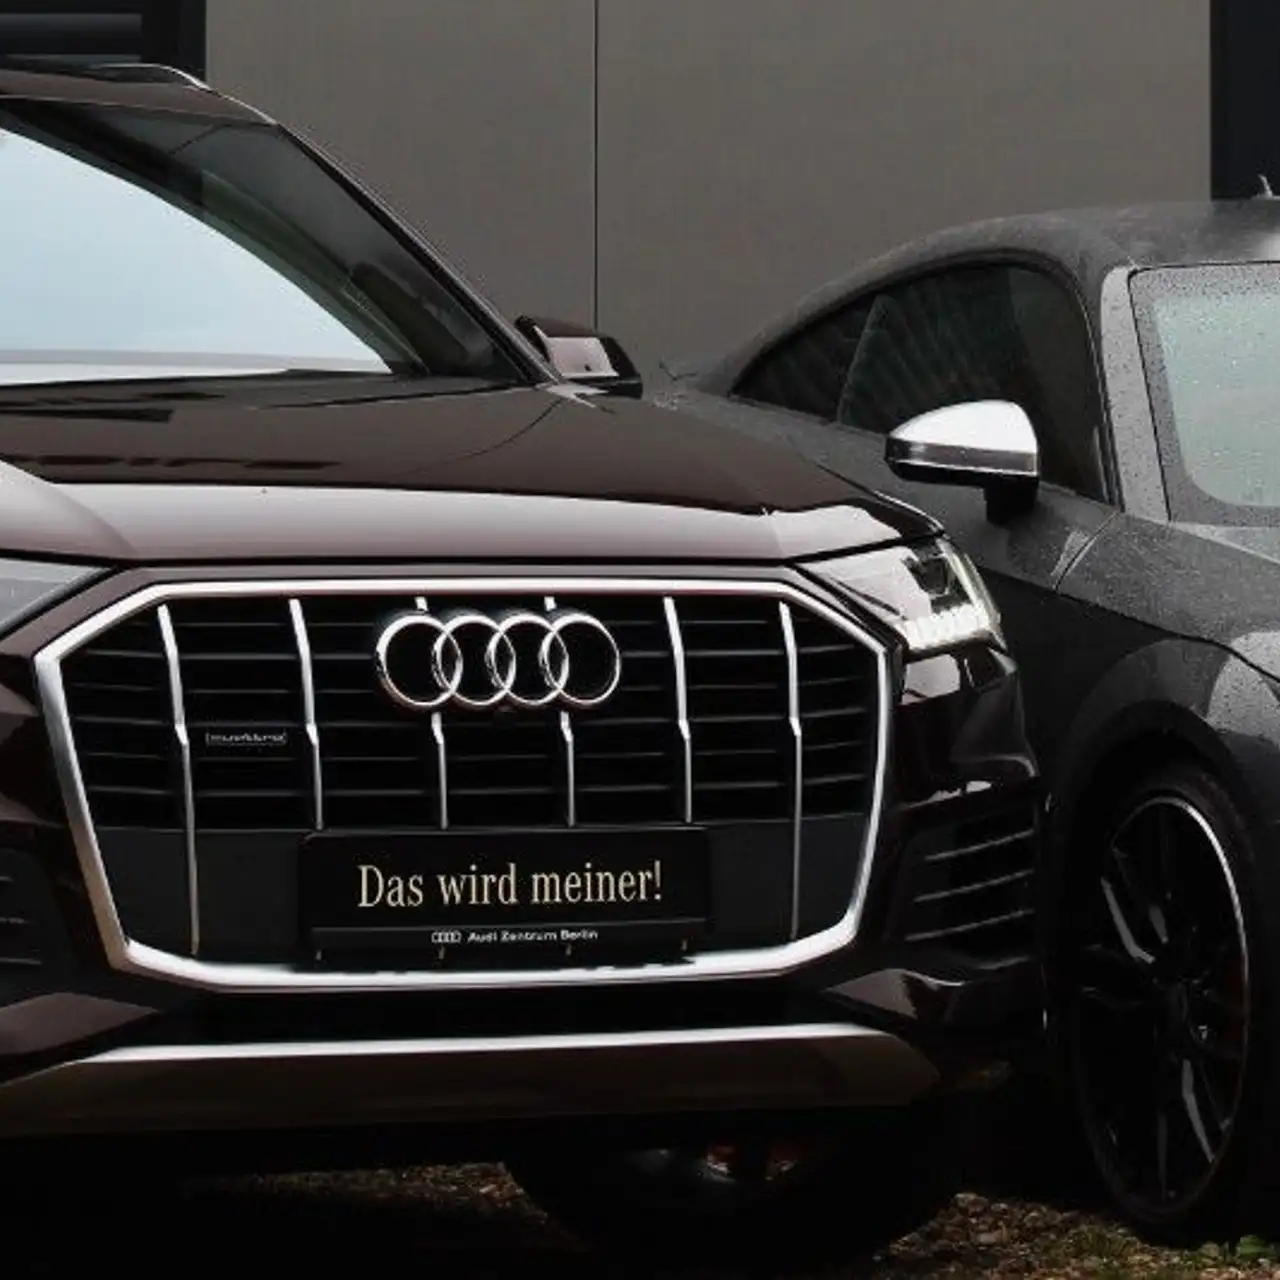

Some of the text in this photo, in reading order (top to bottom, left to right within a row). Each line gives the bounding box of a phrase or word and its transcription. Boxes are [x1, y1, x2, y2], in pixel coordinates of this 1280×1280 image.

[357, 859, 663, 908] Das wird meiner!
[467, 928, 599, 943] Audi Zentrum Berlin
